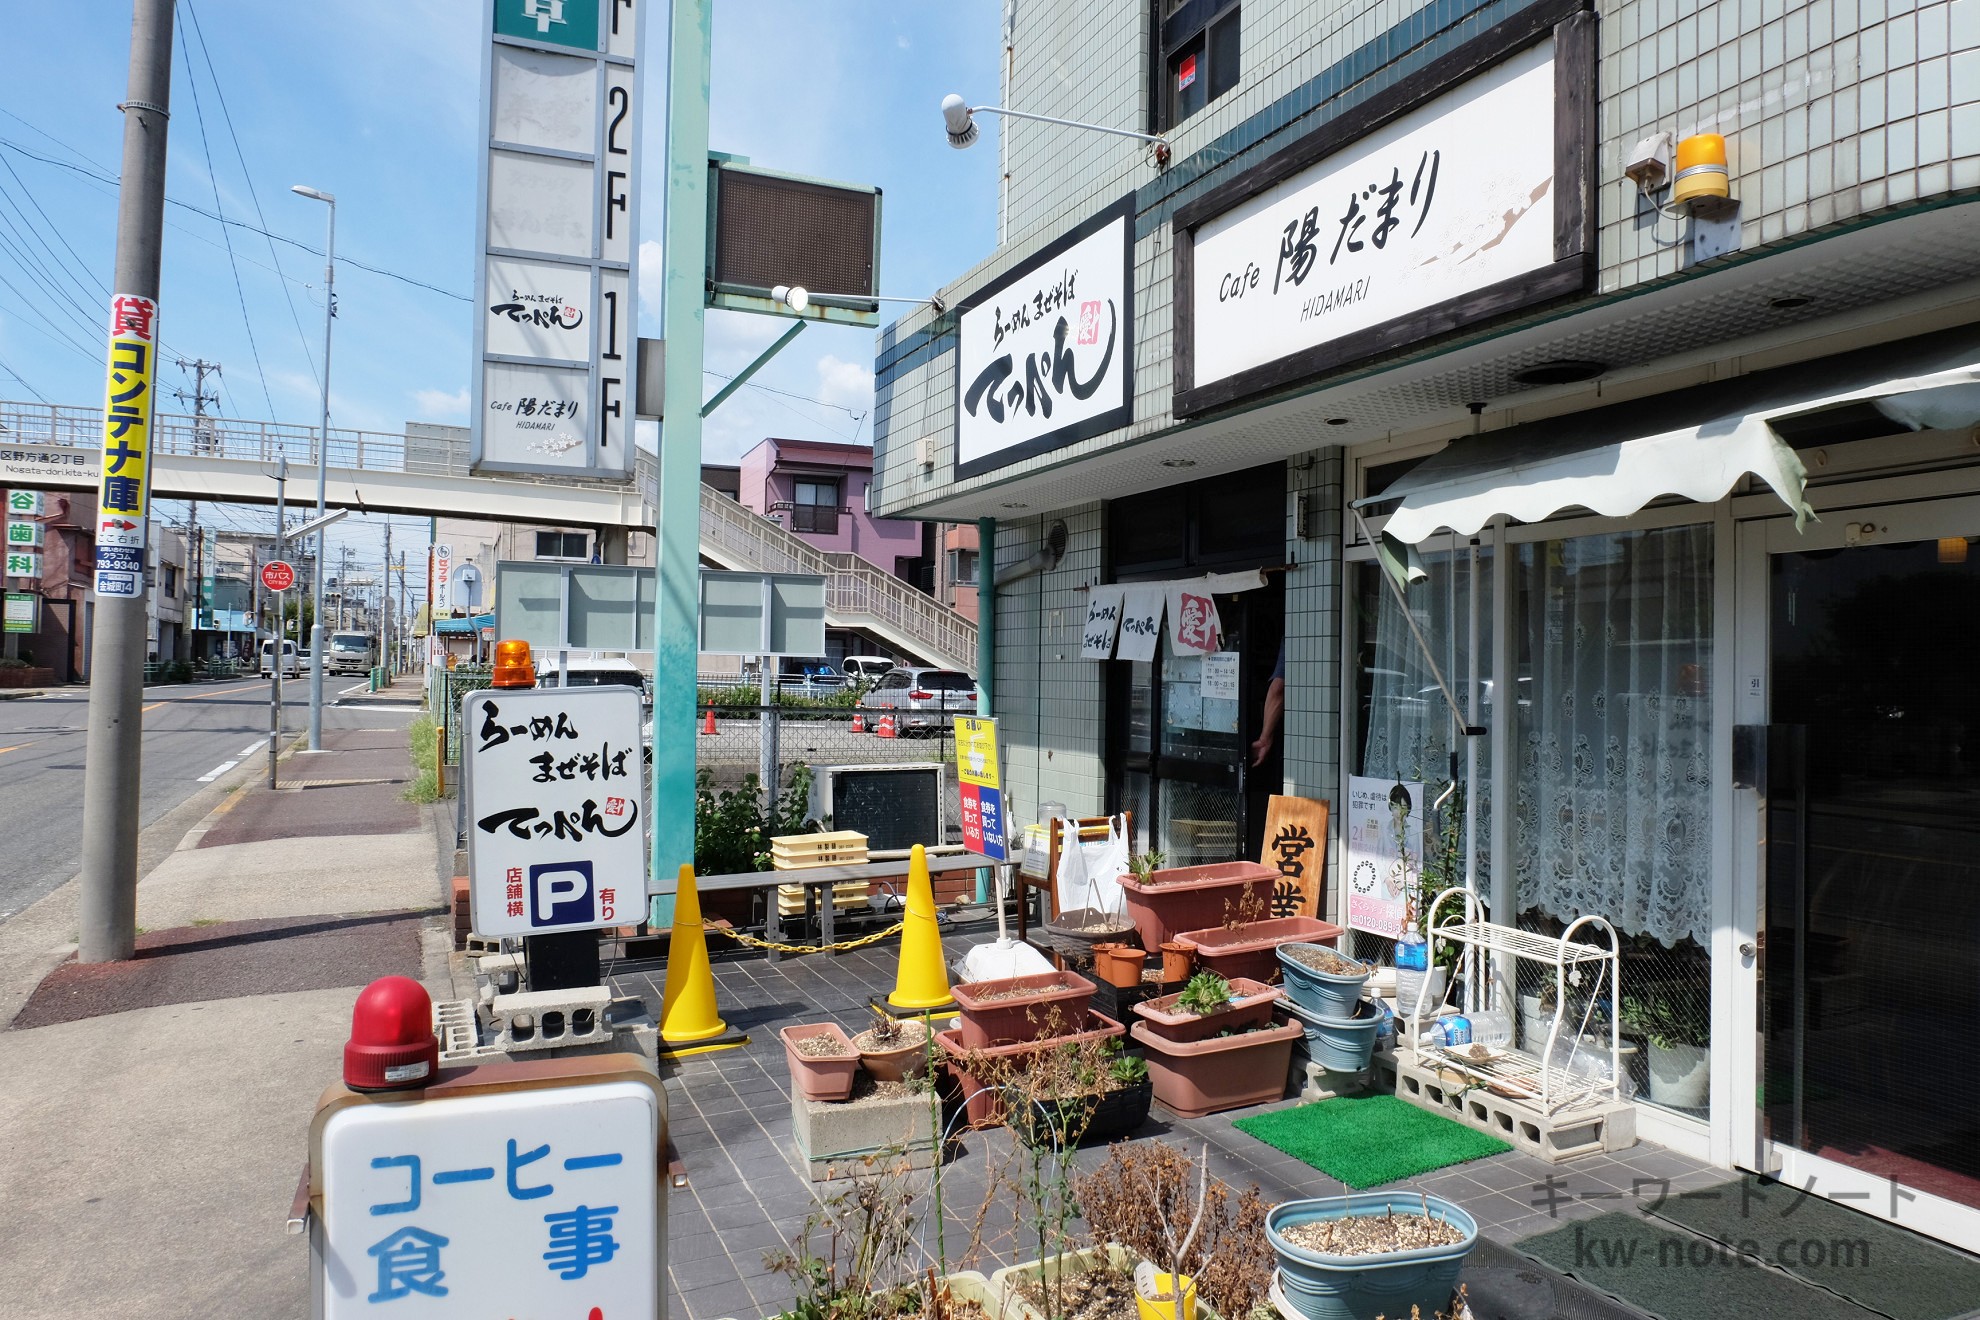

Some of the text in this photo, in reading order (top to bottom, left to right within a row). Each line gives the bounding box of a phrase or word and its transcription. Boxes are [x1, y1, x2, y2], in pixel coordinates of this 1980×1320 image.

[1219, 261, 1260, 302] Cafe
[512, 289, 536, 302] らーめん
[1300, 276, 1371, 323] HIDAMARI
[490, 303, 583, 330] てっぺん
[993, 269, 1078, 353] らーめん まぜそば
[964, 298, 1116, 424] てっぺん
[491, 401, 512, 411] Cafe
[516, 421, 555, 431] HIDAMARI
[265, 571, 290, 580] 市バス
[1122, 616, 1158, 636] てっぺん
[478, 700, 579, 753] らーめん
[966, 719, 982, 731] お願い
[529, 741, 633, 783] まぜそば
[963, 796, 978, 811] 食券を
[980, 801, 996, 815] 食券を
[477, 798, 638, 843] てっぺん
[964, 810, 978, 824] 買って
[981, 815, 996, 830] 買って
[965, 825, 980, 840] いる方
[983, 831, 1004, 847] いない方
[506, 867, 524, 918] 店舗横
[537, 870, 588, 921] P
[599, 888, 616, 921] 有り
[369, 1138, 623, 1216] コーヒー
